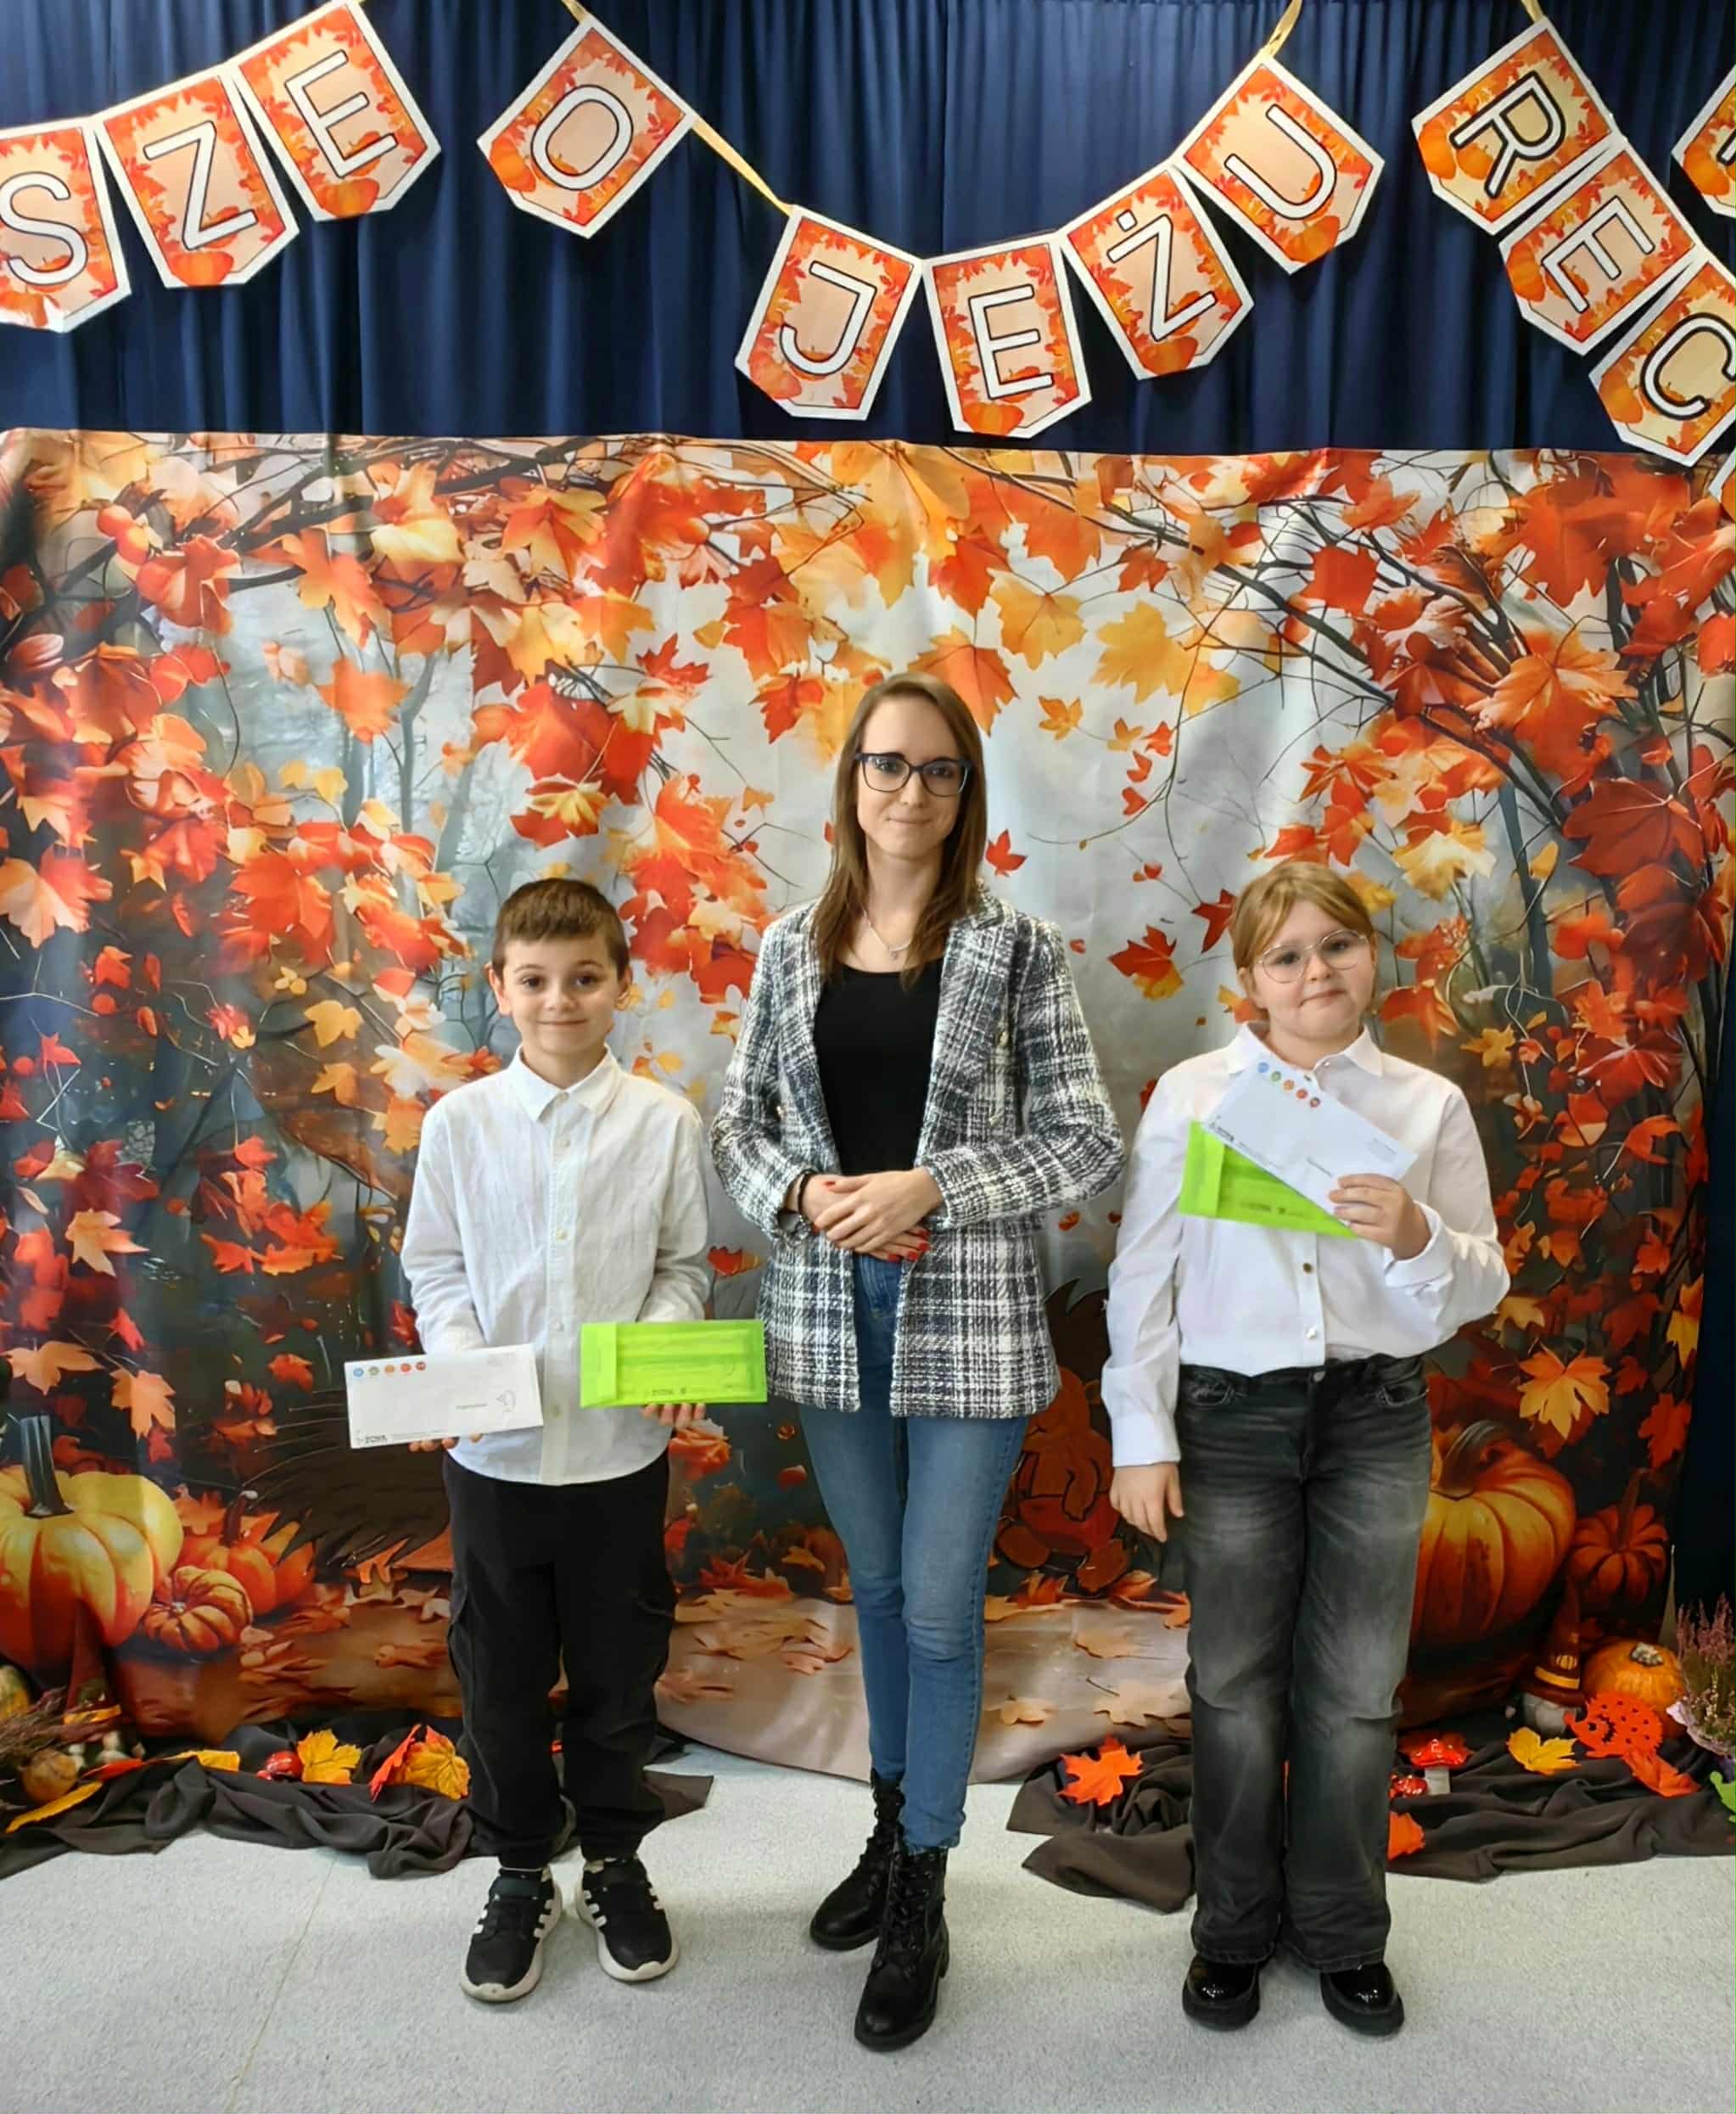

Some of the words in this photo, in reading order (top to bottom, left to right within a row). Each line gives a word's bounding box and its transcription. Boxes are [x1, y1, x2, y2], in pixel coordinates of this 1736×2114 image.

[0, 49, 398, 286] SZE
[530, 83, 634, 191] O
[779, 104, 1338, 401] JEŻU
